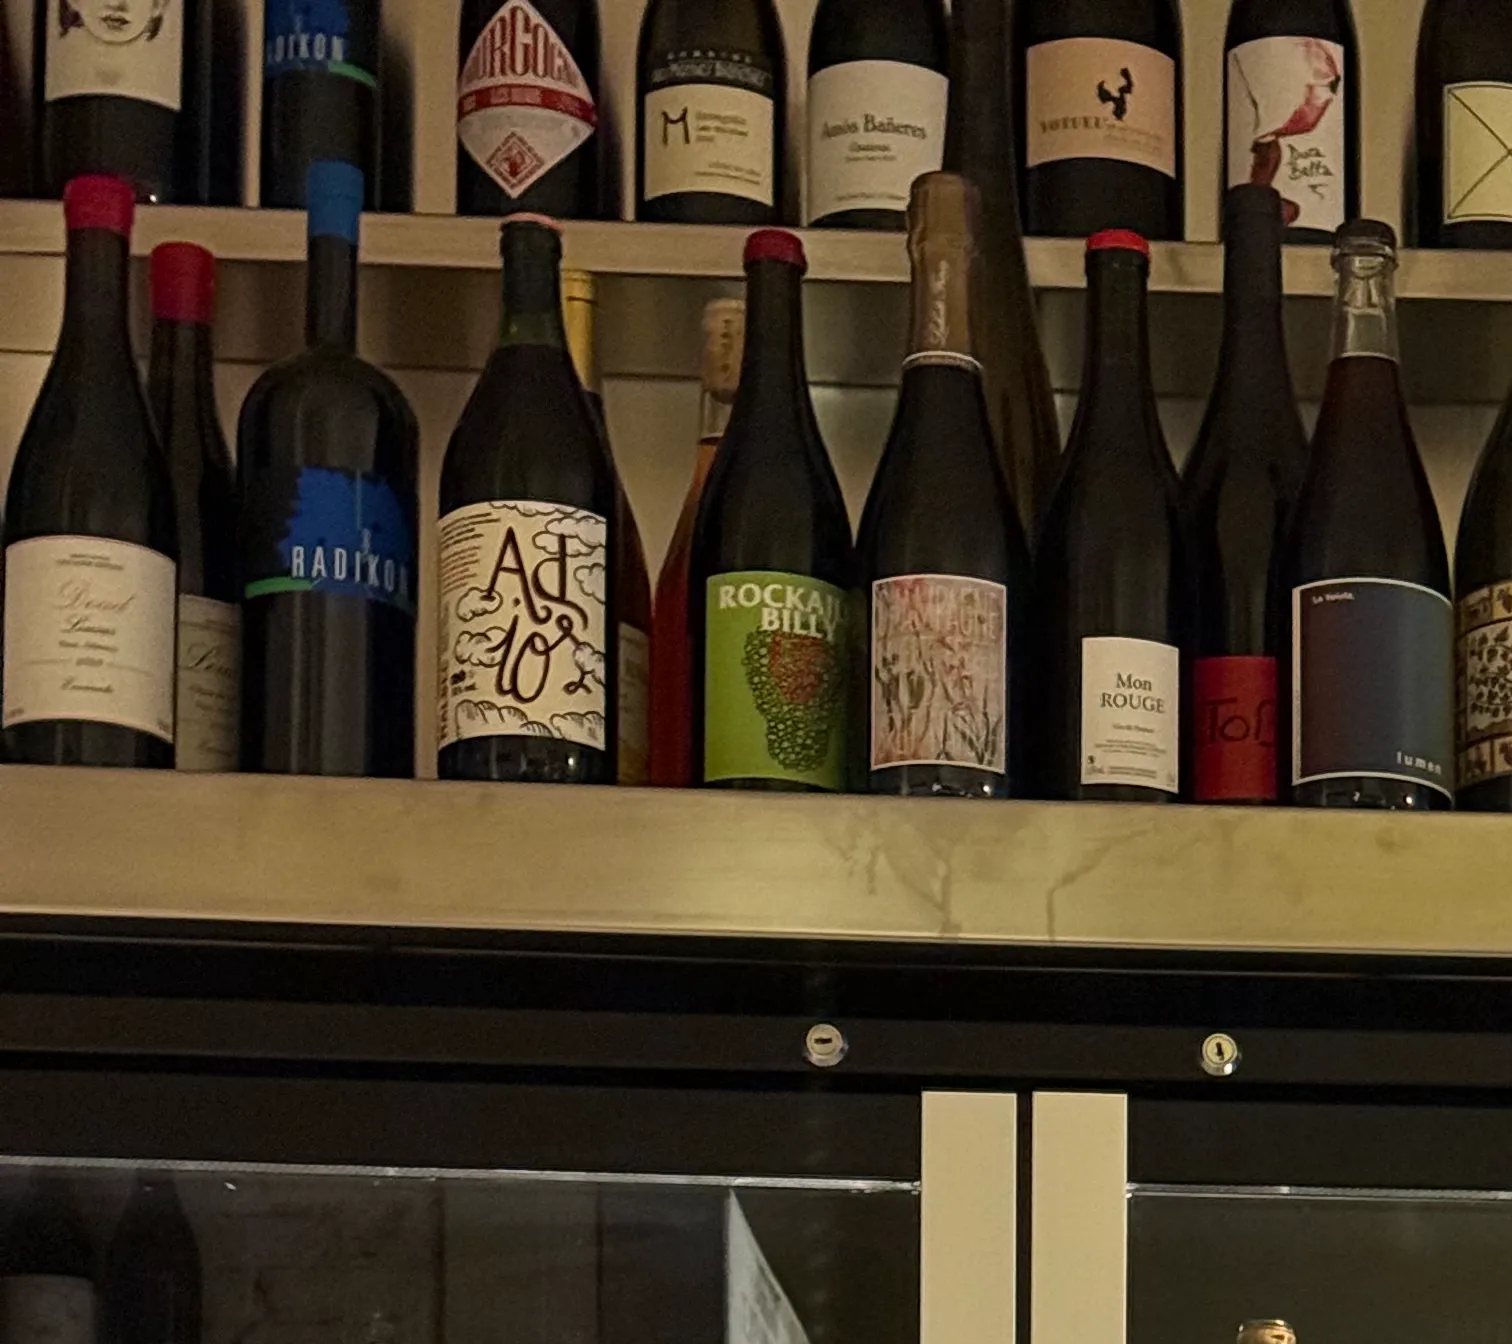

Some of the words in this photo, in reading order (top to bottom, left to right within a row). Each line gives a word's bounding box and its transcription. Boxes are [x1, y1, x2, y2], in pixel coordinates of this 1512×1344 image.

[267, 33, 344, 62] DIKON
[1115, 672, 1153, 693] Mon
[1099, 692, 1167, 715] ROUGE
[1396, 750, 1443, 776] lumen
